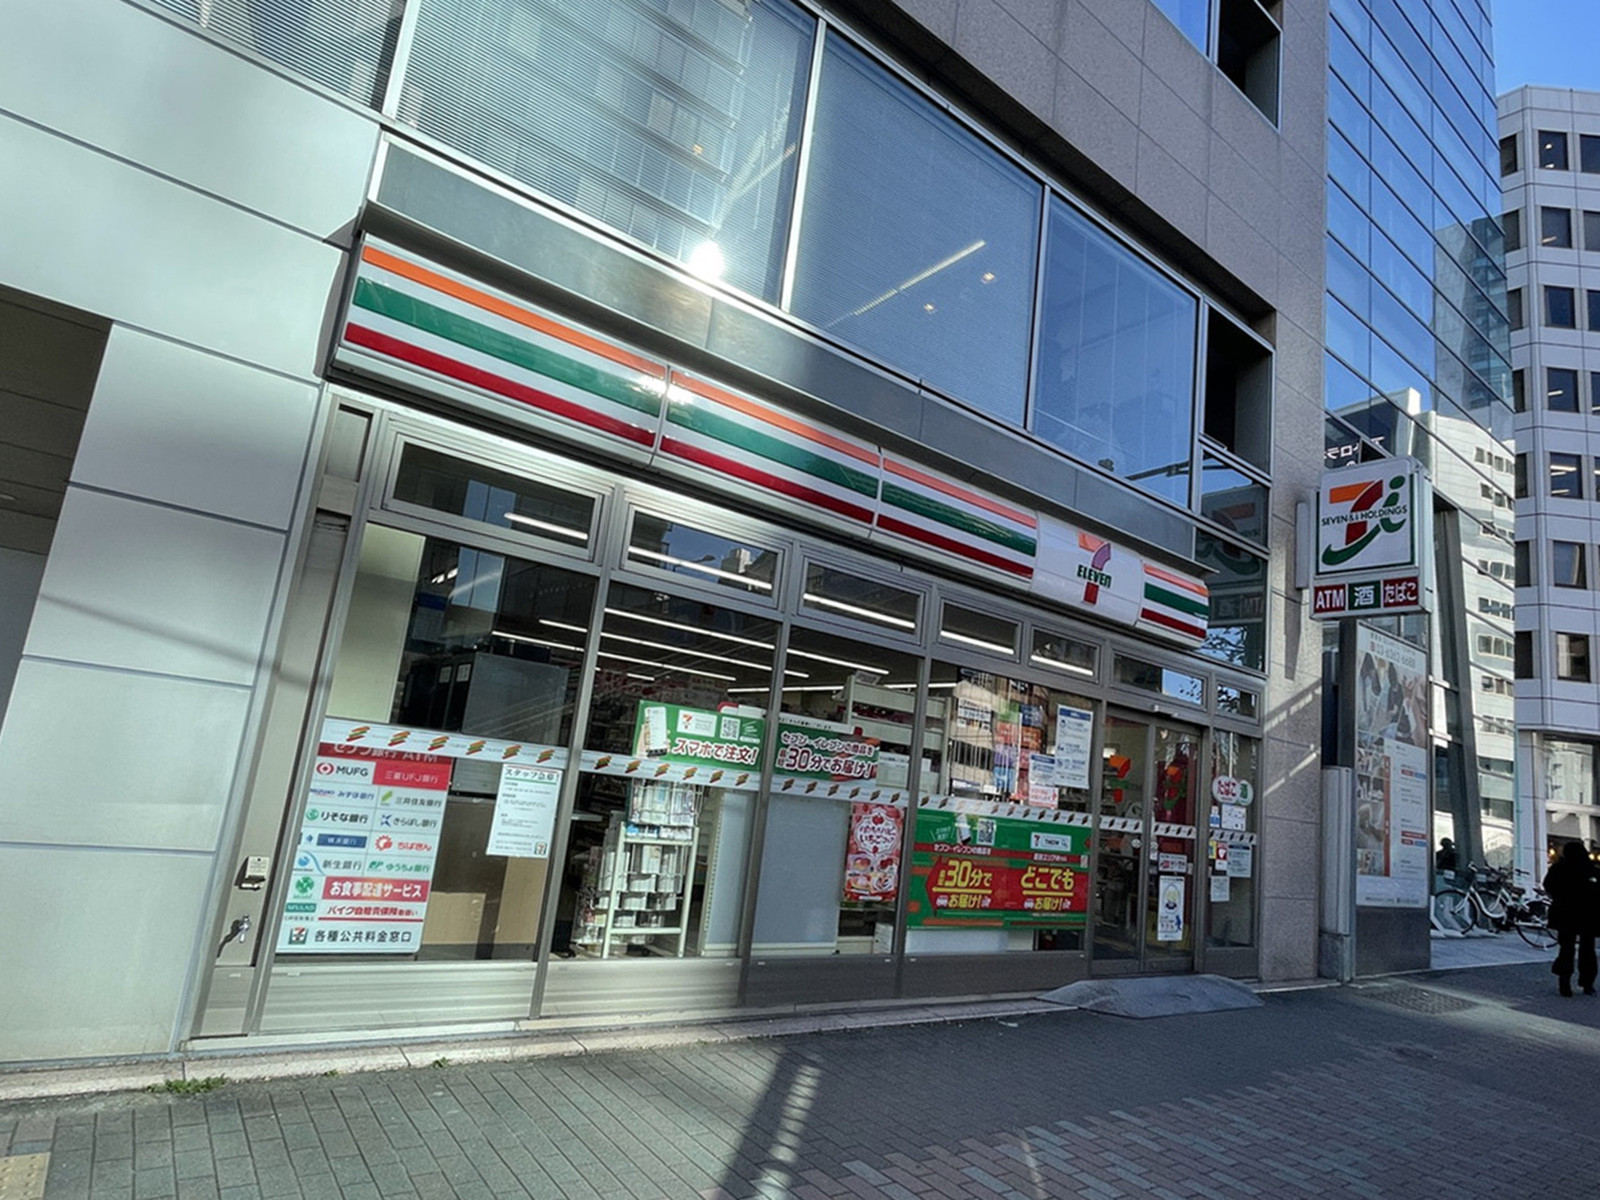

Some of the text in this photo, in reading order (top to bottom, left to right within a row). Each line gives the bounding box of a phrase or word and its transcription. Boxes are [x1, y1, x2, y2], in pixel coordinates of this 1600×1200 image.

[1361, 506, 1408, 520] HOLDINGS
[1315, 588, 1345, 610] ATM
[1353, 586, 1375, 607] 酒
[1384, 582, 1418, 604] たばこ
[673, 739, 759, 764] スマホで注文!
[335, 765, 369, 777] MUFG
[384, 770, 439, 784] 三菱UFJ銀行
[321, 810, 369, 824] りそな銀行
[393, 817, 438, 828] きらぼし銀行
[322, 859, 362, 871] 新生銀行
[1020, 865, 1075, 890] どこでも
[314, 929, 412, 943] 各種公共料金窓口
